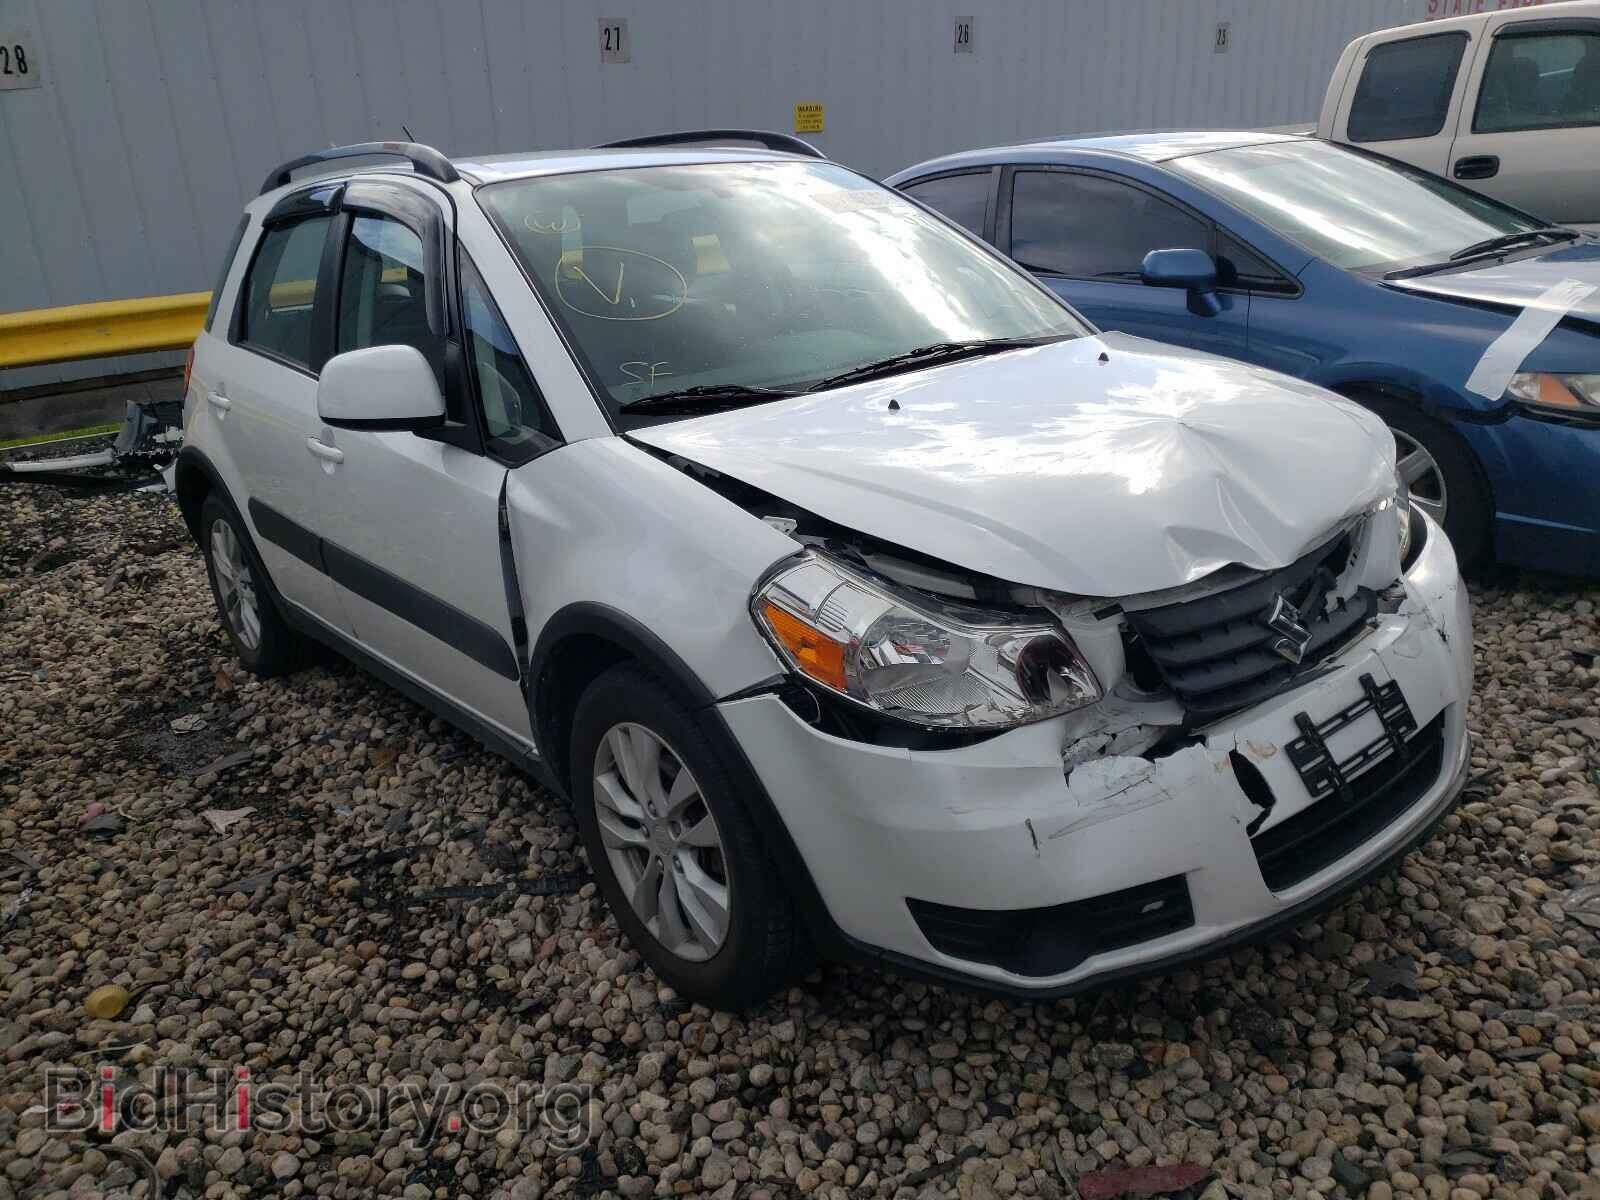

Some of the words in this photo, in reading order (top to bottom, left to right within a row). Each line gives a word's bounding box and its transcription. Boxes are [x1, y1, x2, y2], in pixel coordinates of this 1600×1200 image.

[604, 27, 620, 51] 27
[958, 24, 969, 44] 26
[0, 45, 28, 74] 28
